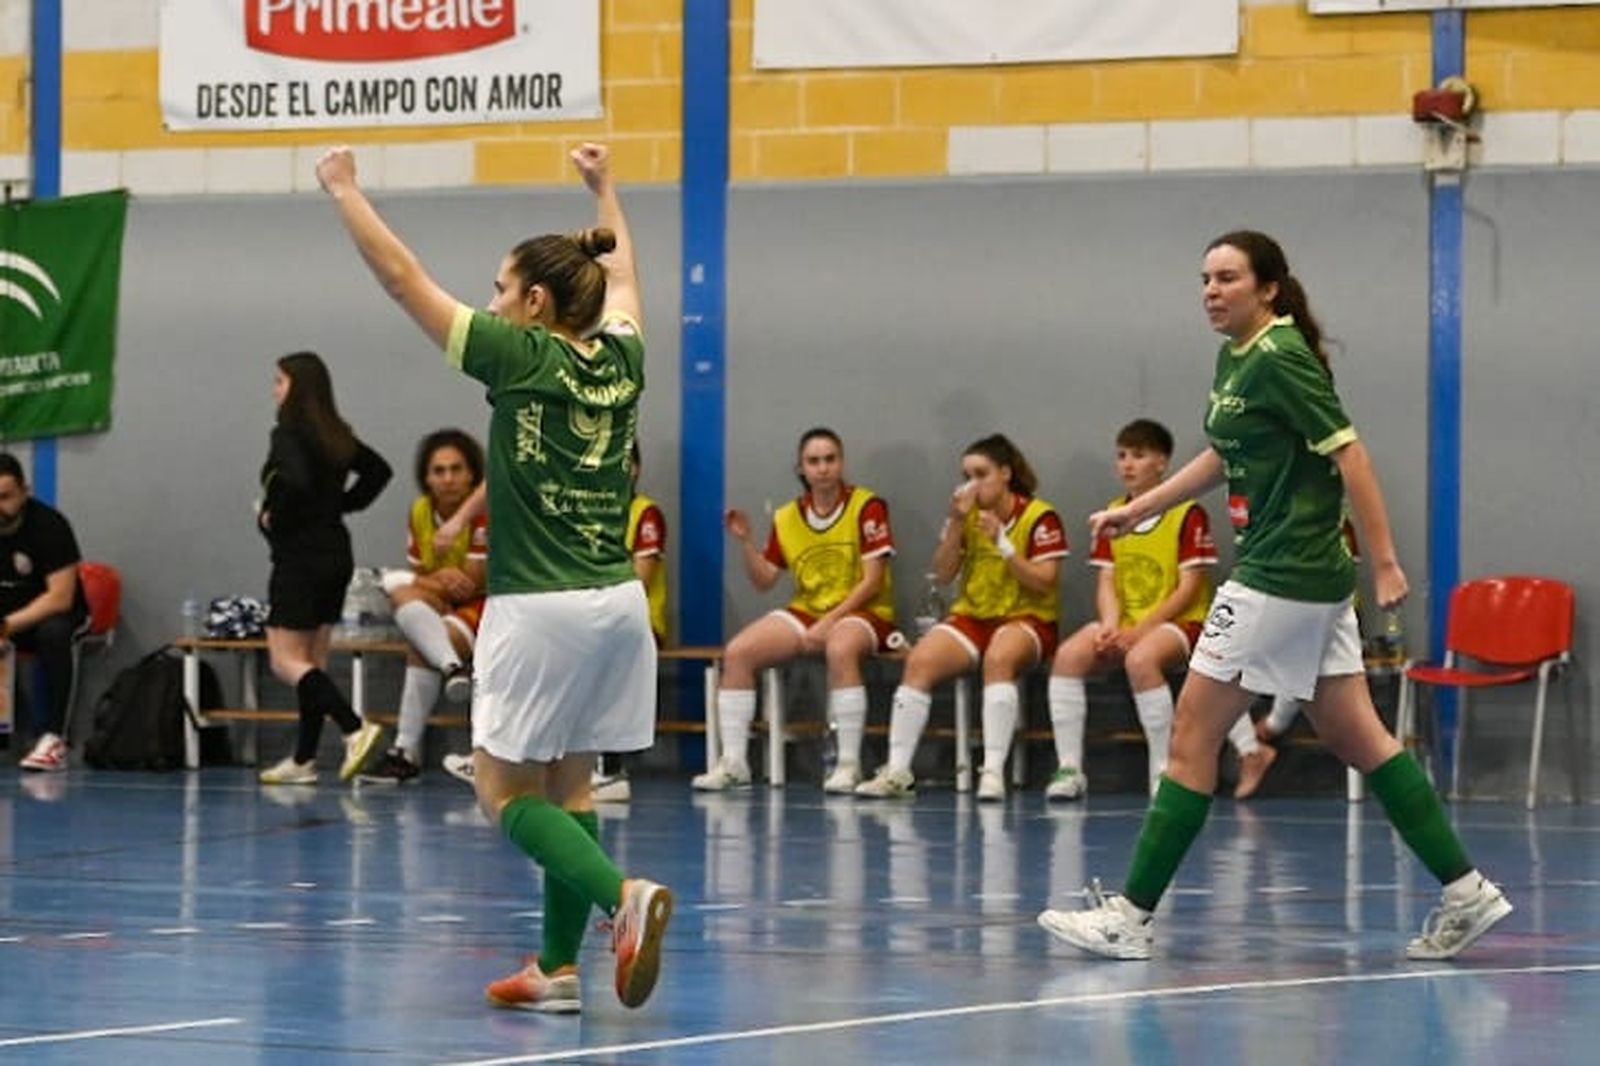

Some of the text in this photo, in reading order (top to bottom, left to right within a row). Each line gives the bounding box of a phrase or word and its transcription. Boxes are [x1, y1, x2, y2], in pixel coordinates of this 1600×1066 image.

[197, 73, 562, 119] DESDE EL CAMPO CON AMOR
[568, 401, 613, 472] 9
